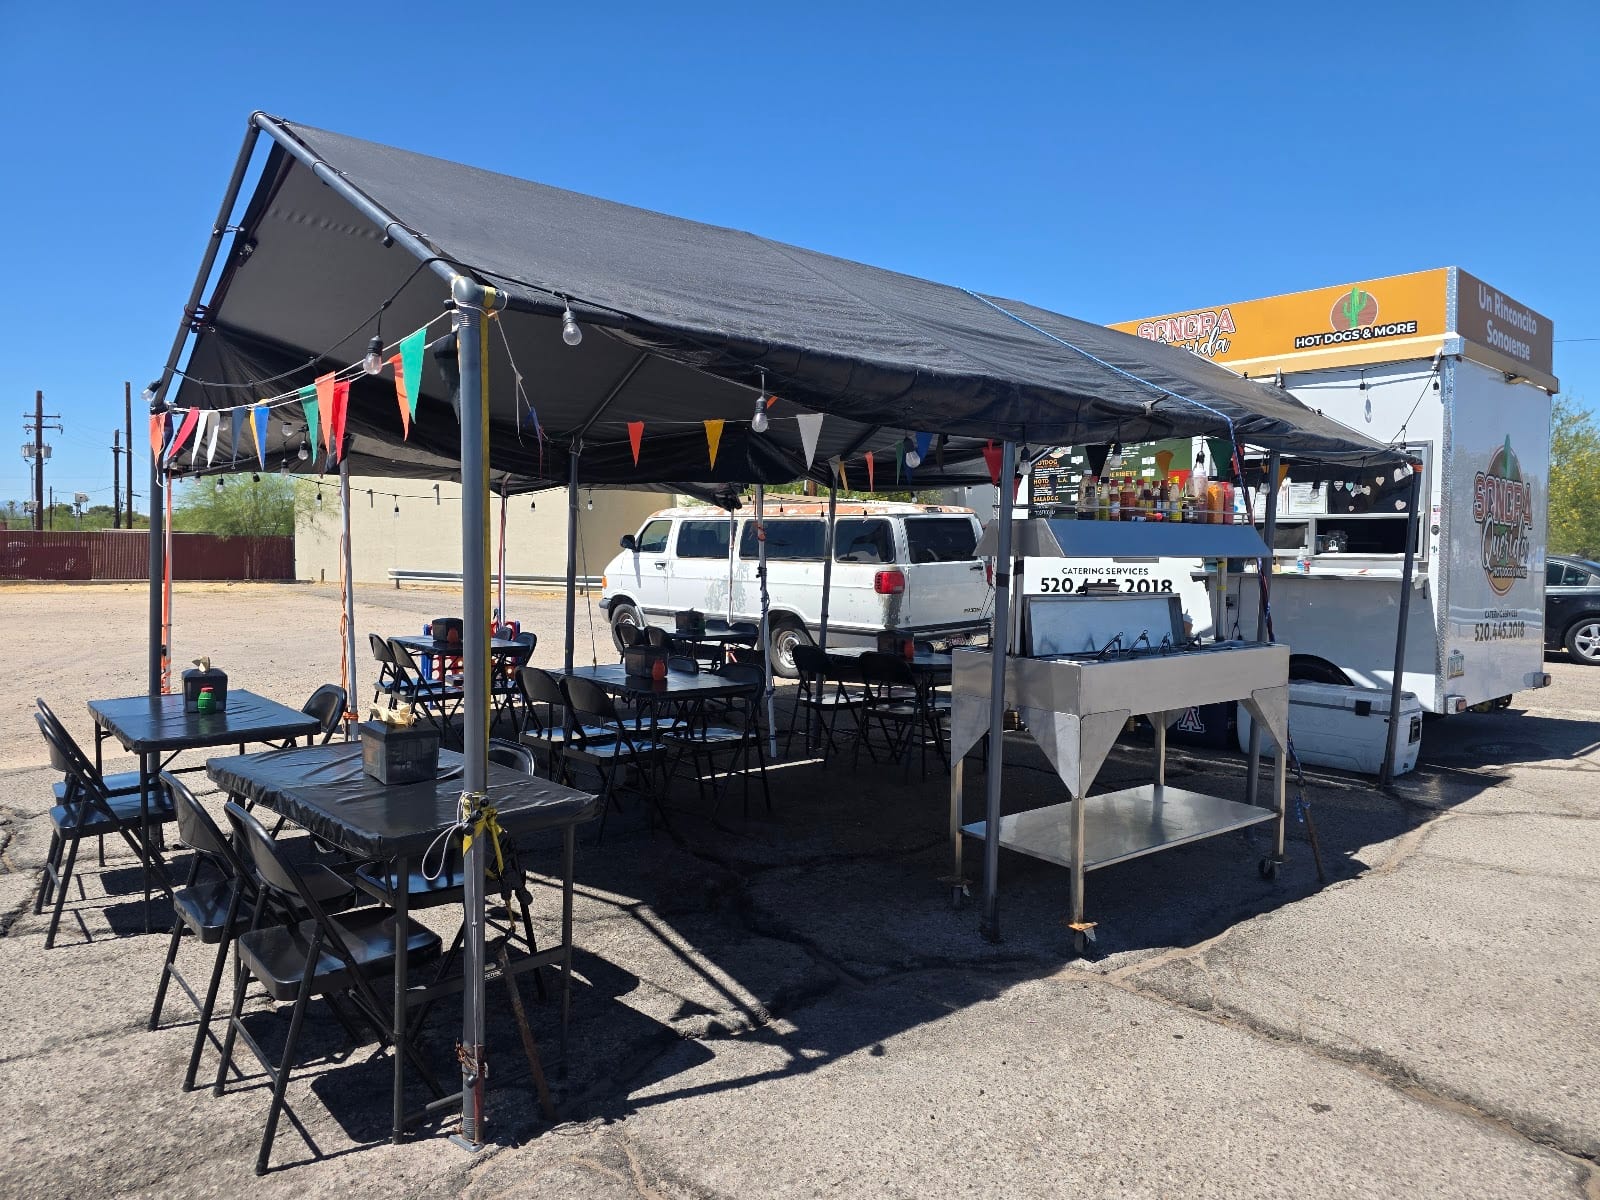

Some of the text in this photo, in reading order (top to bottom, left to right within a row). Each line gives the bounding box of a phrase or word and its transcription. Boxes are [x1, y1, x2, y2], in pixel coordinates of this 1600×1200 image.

[1137, 308, 1236, 343] SONORA
[1478, 283, 1537, 336] Un Rinconcito
[1158, 326, 1232, 357] rida
[1295, 322, 1416, 348] HOT DOGS & MORE
[1486, 319, 1531, 360] Sonorense
[1473, 471, 1533, 530] SONORA
[1062, 567, 1149, 576] CATERING SERVICES
[1474, 620, 1525, 642] 520.445.2018
